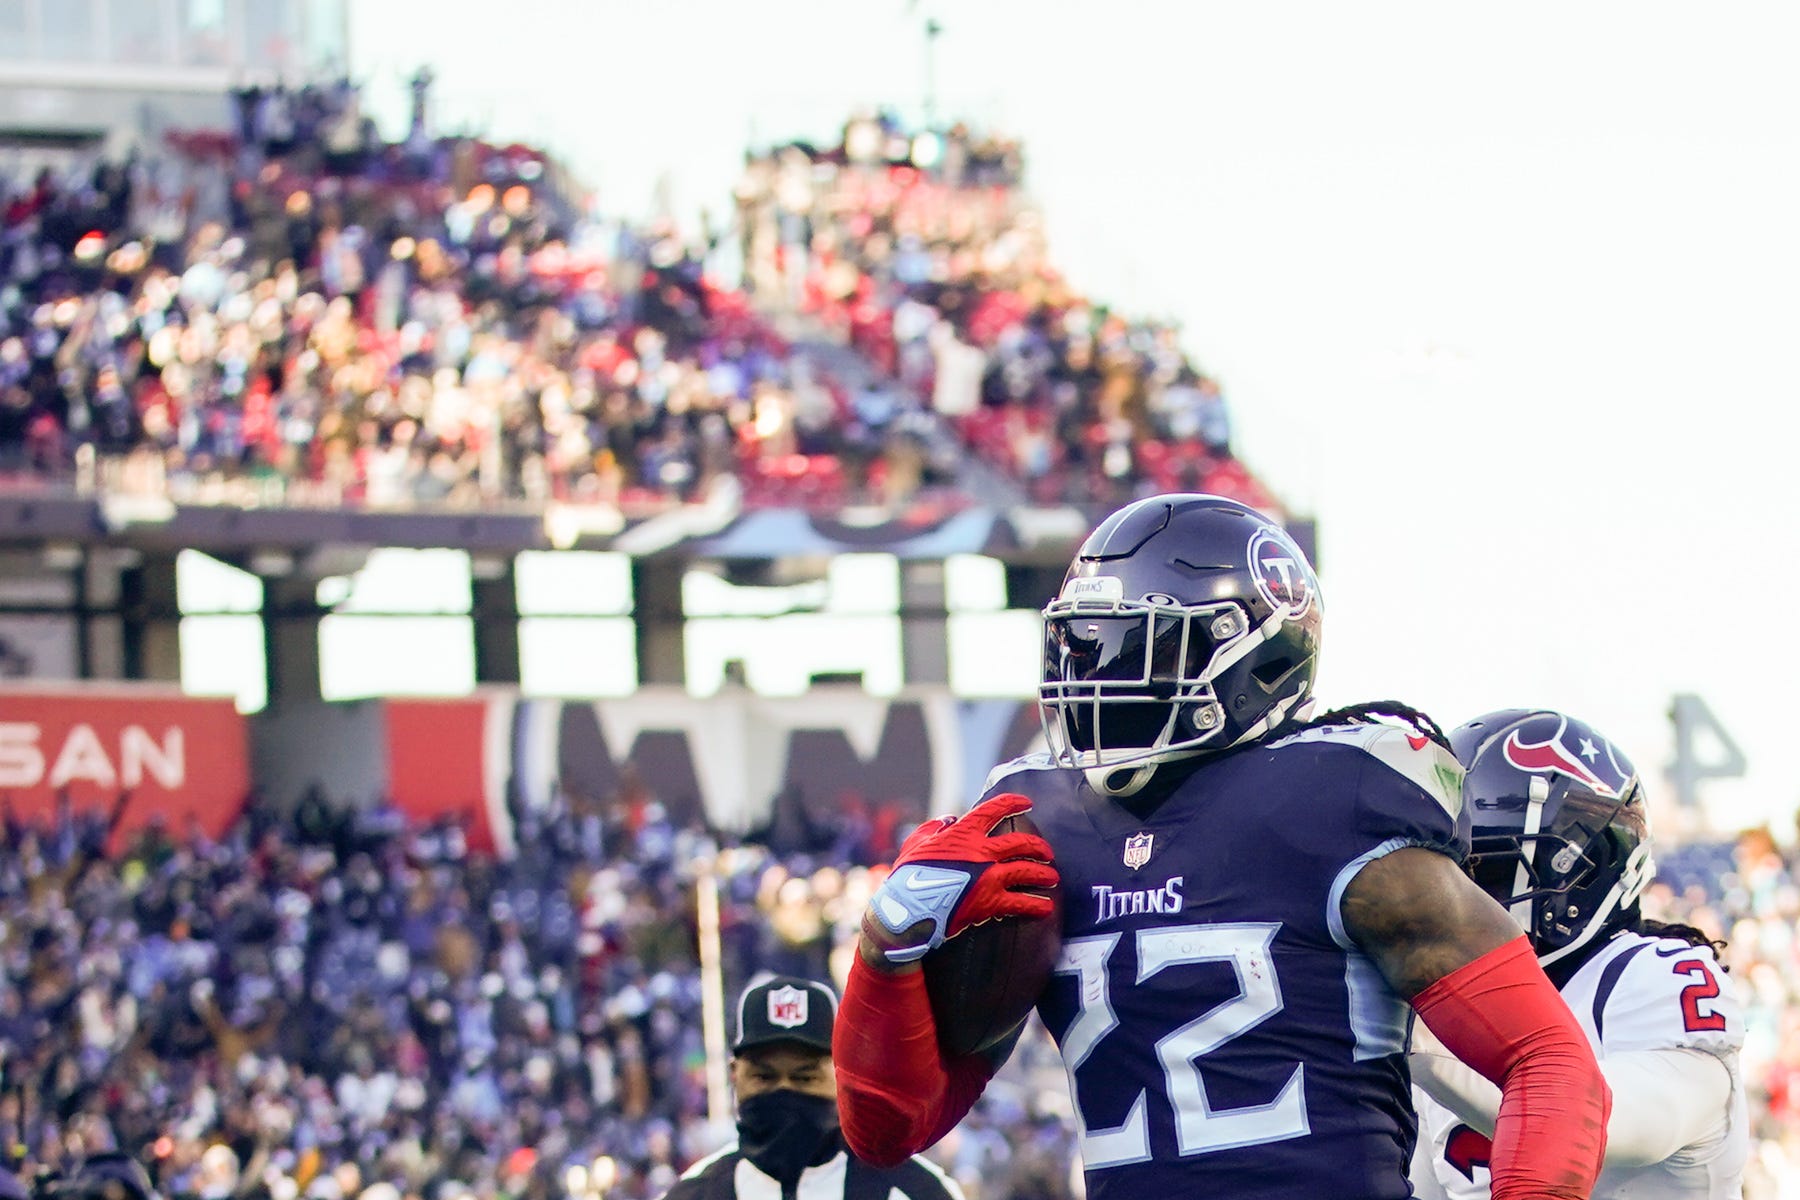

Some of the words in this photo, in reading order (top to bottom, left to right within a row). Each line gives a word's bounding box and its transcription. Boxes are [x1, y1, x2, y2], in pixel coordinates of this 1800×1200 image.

[1091, 876, 1184, 925] TITANS
[1672, 959, 1727, 1033] 2
[1056, 921, 1312, 1171] 22
